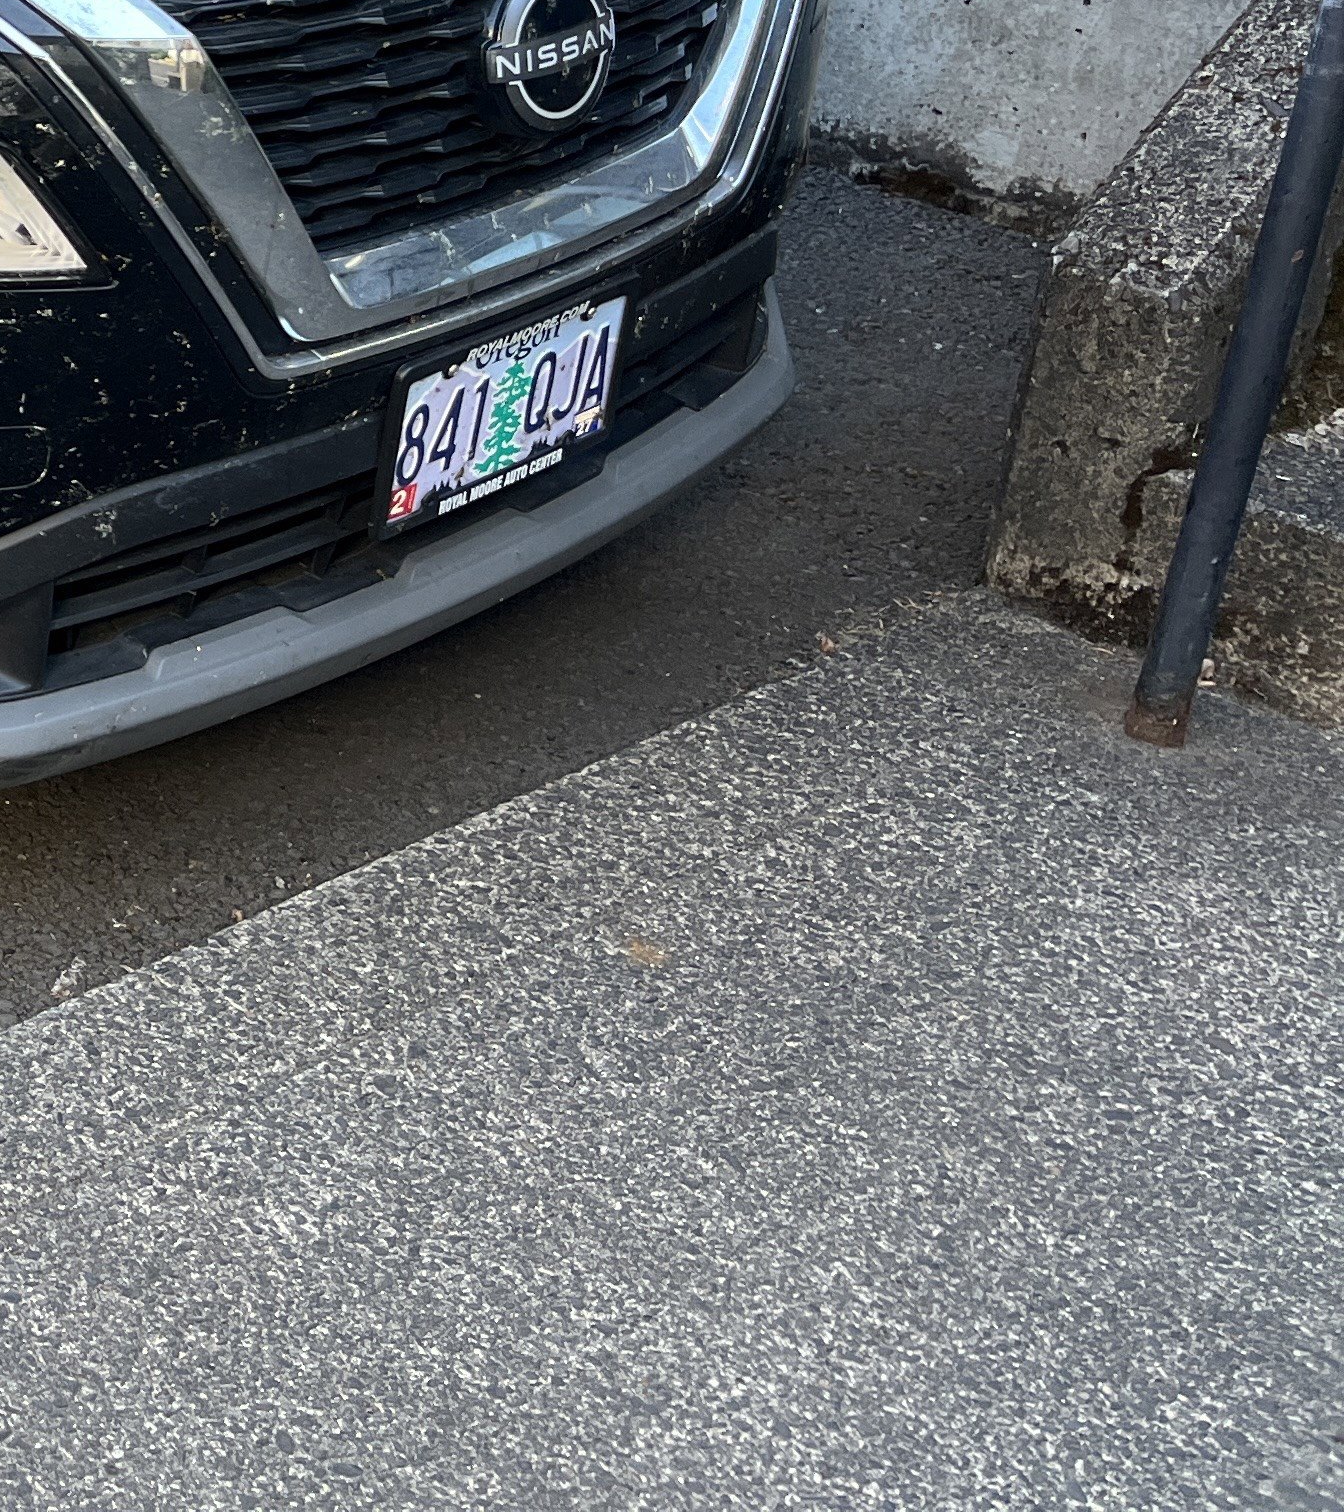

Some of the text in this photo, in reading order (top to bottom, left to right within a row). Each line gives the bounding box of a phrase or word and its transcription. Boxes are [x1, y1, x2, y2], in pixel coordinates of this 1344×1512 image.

[495, 19, 614, 78] NISSAN
[396, 325, 610, 487] 841 QJA
[390, 489, 407, 515] 2
[438, 490, 468, 515] ROYAL
[469, 475, 504, 502] MOORE
[503, 464, 529, 487] AUTO
[528, 448, 563, 475] CENTER
